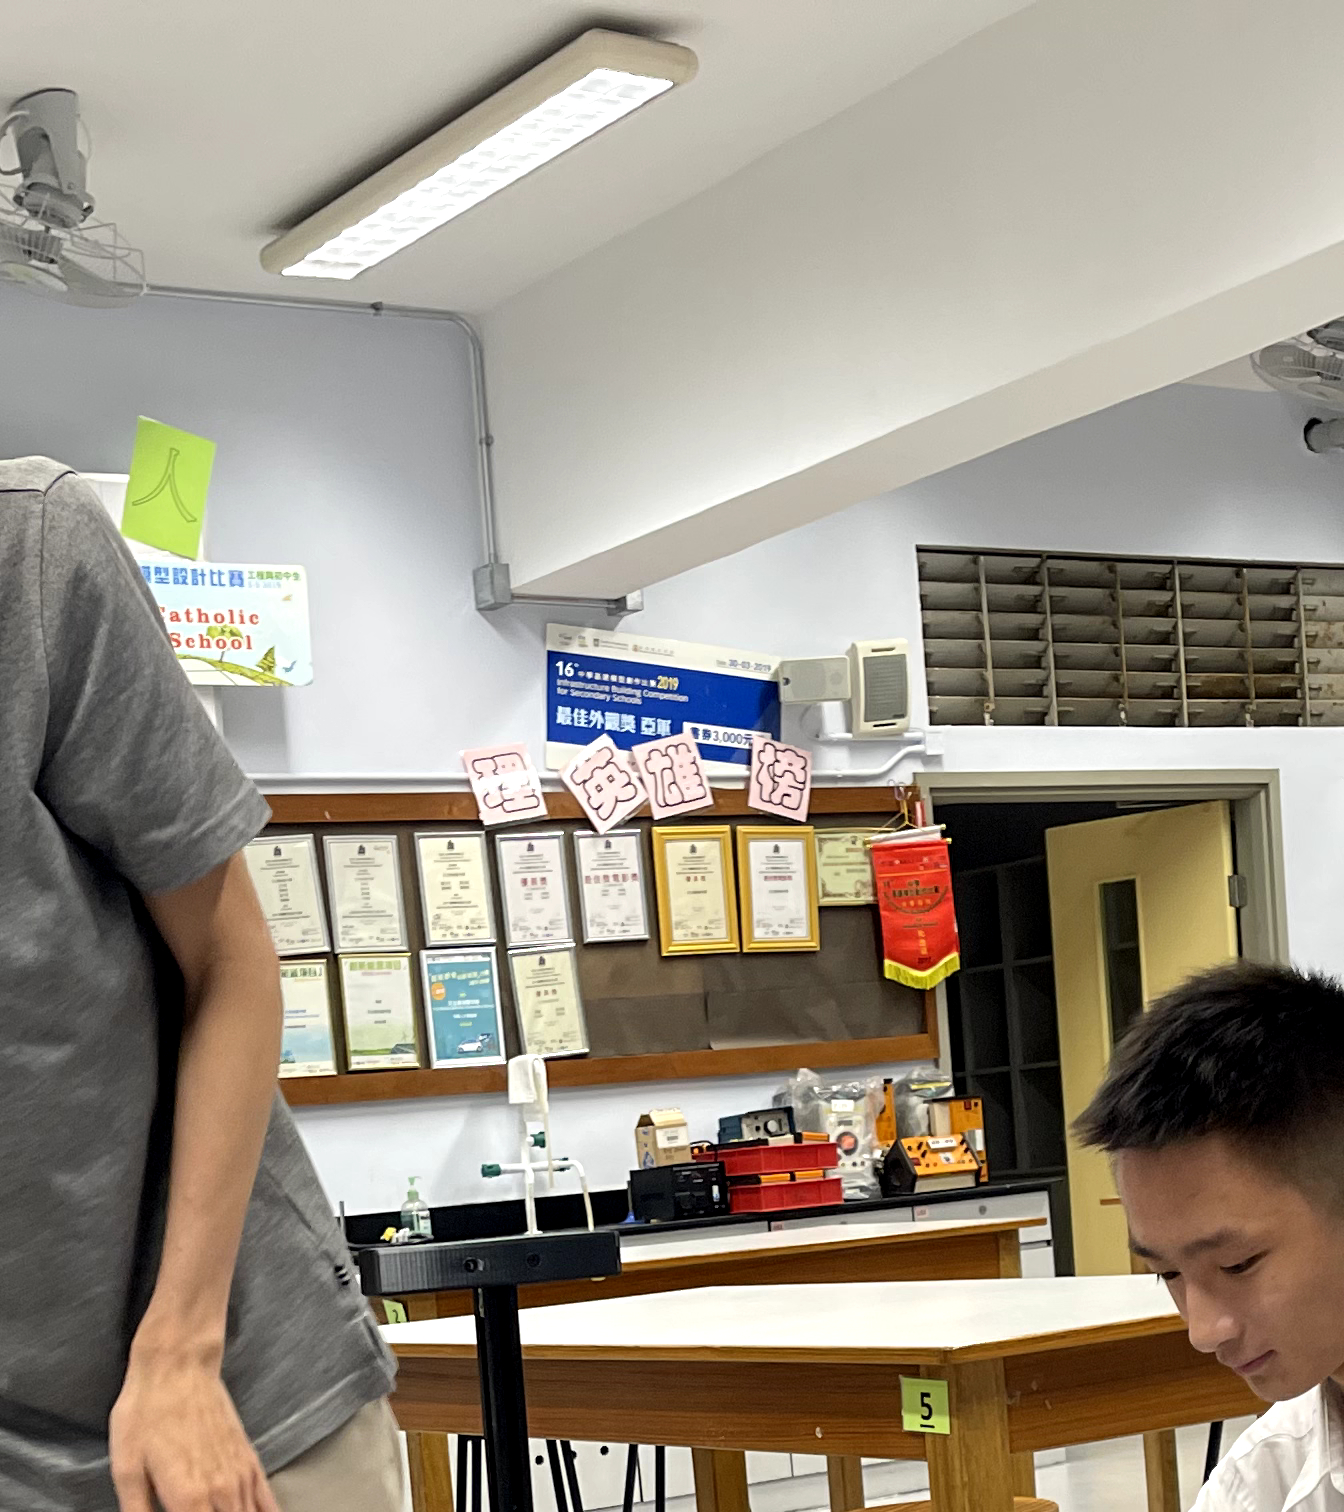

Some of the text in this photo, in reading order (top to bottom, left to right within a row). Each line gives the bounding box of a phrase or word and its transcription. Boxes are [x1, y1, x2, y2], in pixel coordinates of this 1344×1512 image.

[132, 447, 197, 523] 人
[169, 632, 253, 650] School
[657, 675, 679, 691] 2019
[570, 746, 638, 821] 英
[645, 743, 708, 808] 雄
[757, 742, 807, 811] 榜
[392, 1309, 401, 1323] 2
[920, 1392, 933, 1421] 5
